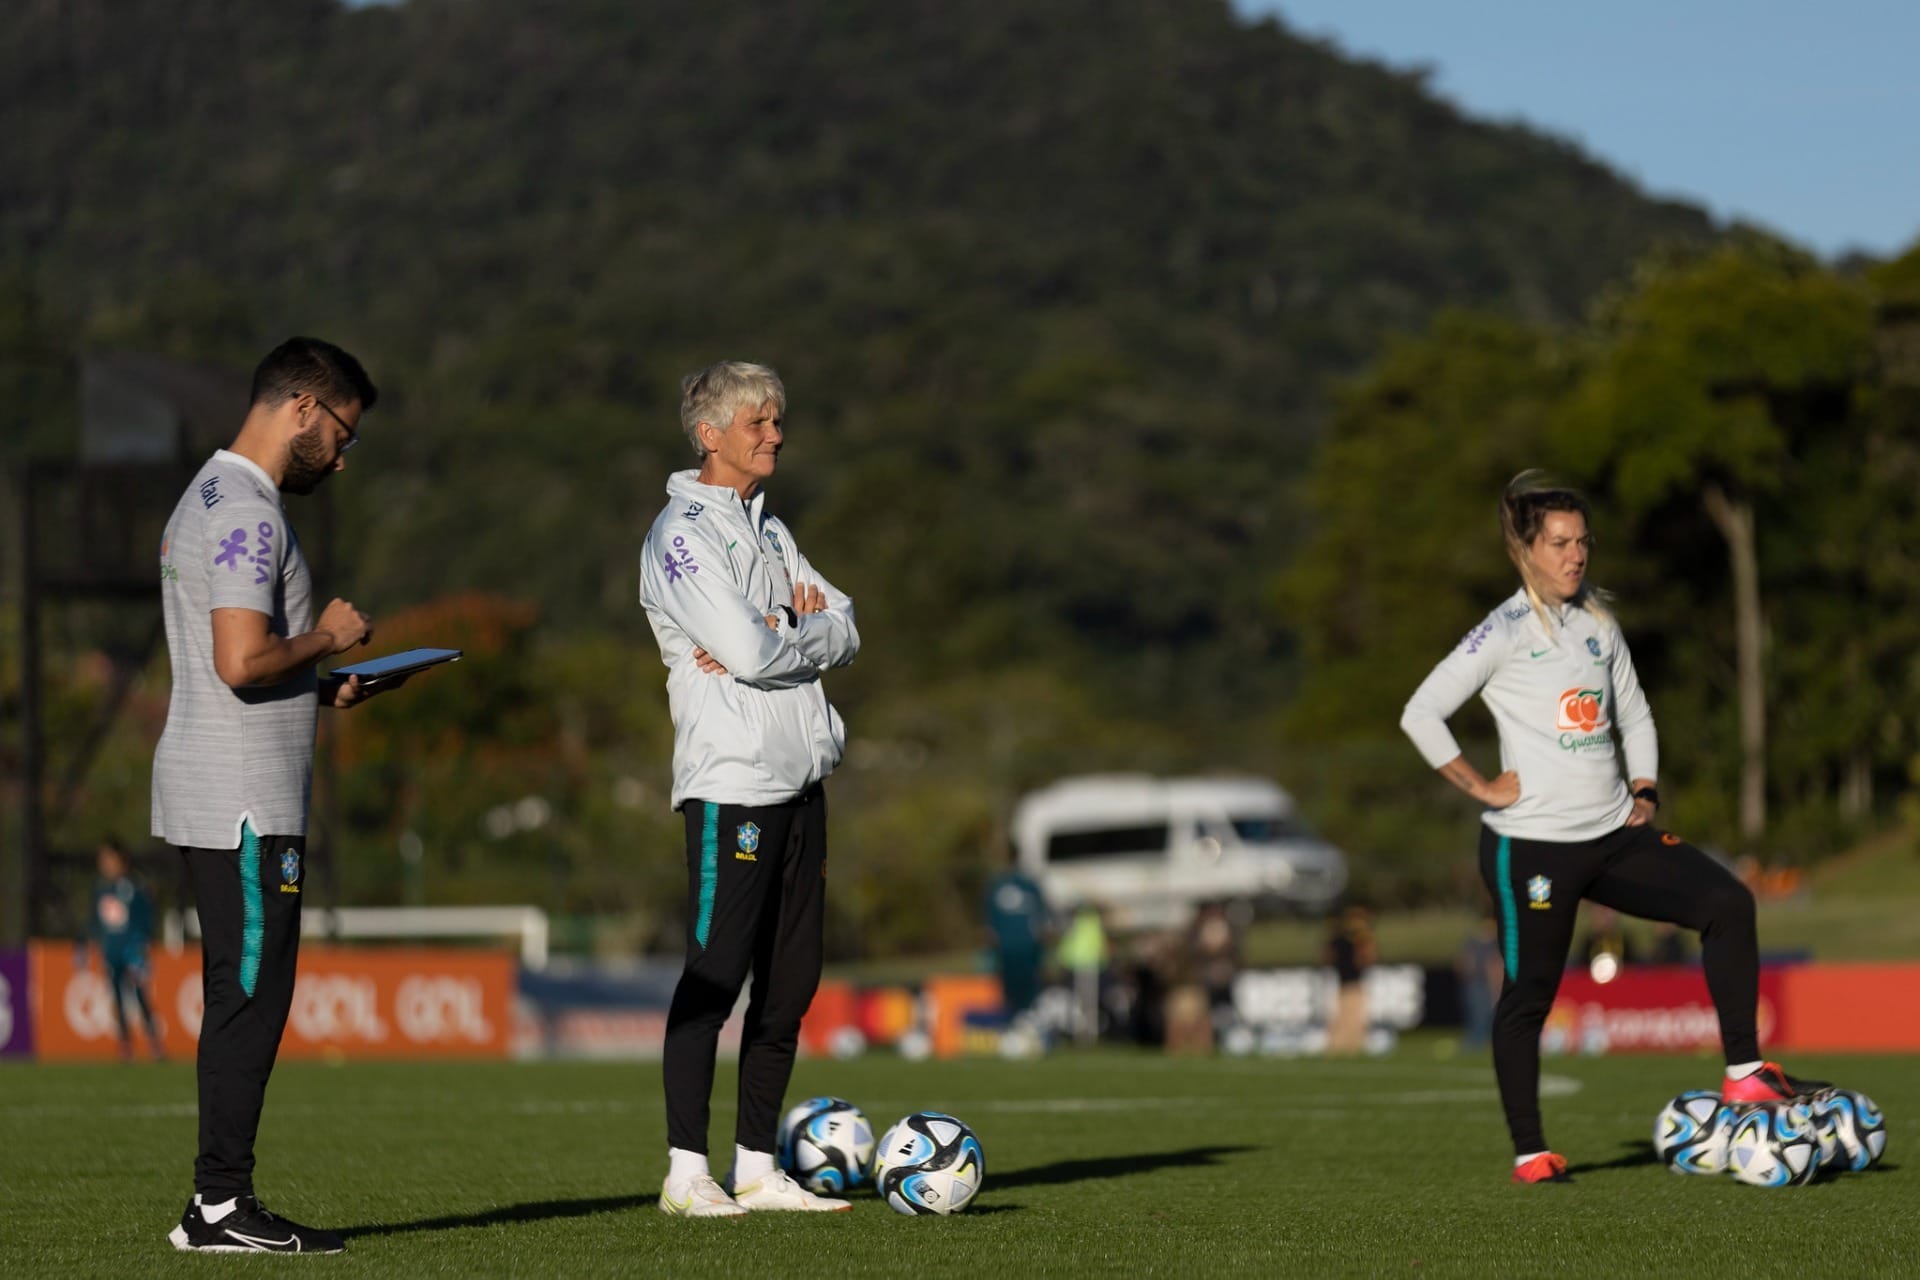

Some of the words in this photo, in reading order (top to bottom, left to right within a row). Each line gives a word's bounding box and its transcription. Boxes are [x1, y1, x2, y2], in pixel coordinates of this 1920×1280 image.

[200, 476, 224, 510] Itaú
[248, 521, 274, 584] vivo
[672, 535, 700, 575] vivo
[1466, 623, 1493, 655] vivo
